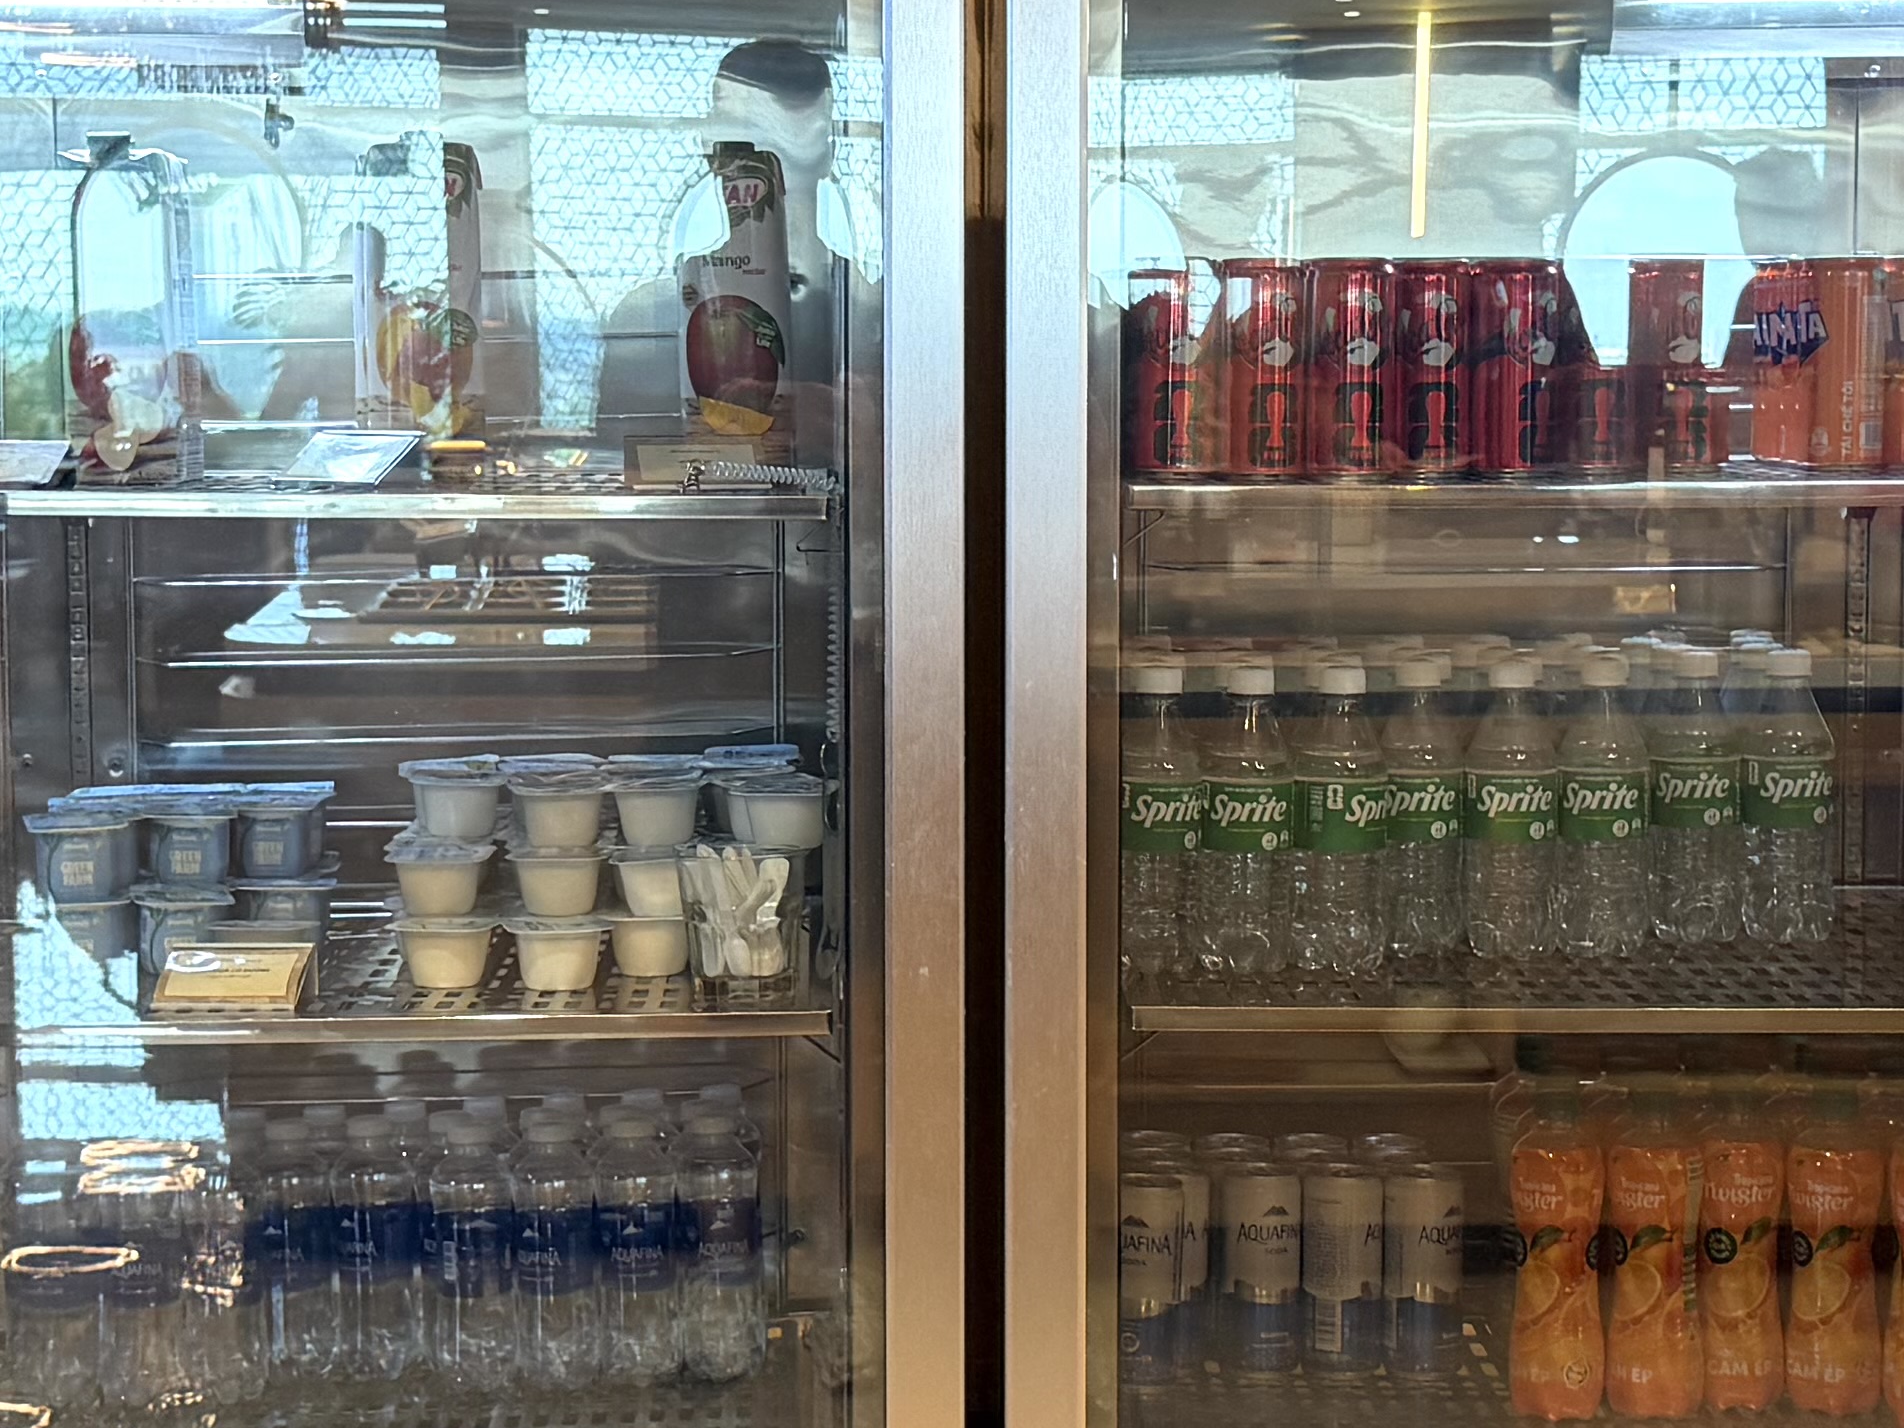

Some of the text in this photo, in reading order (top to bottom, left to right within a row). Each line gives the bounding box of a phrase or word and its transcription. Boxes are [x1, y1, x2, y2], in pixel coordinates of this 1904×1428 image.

[1384, 784, 1455, 816] Sprite
[1477, 783, 1552, 818] Sprite
[1563, 782, 1638, 815] Sprite
[1656, 772, 1730, 803] Sprite
[1760, 771, 1834, 806] Sprite
[1210, 794, 1287, 827] Sprite
